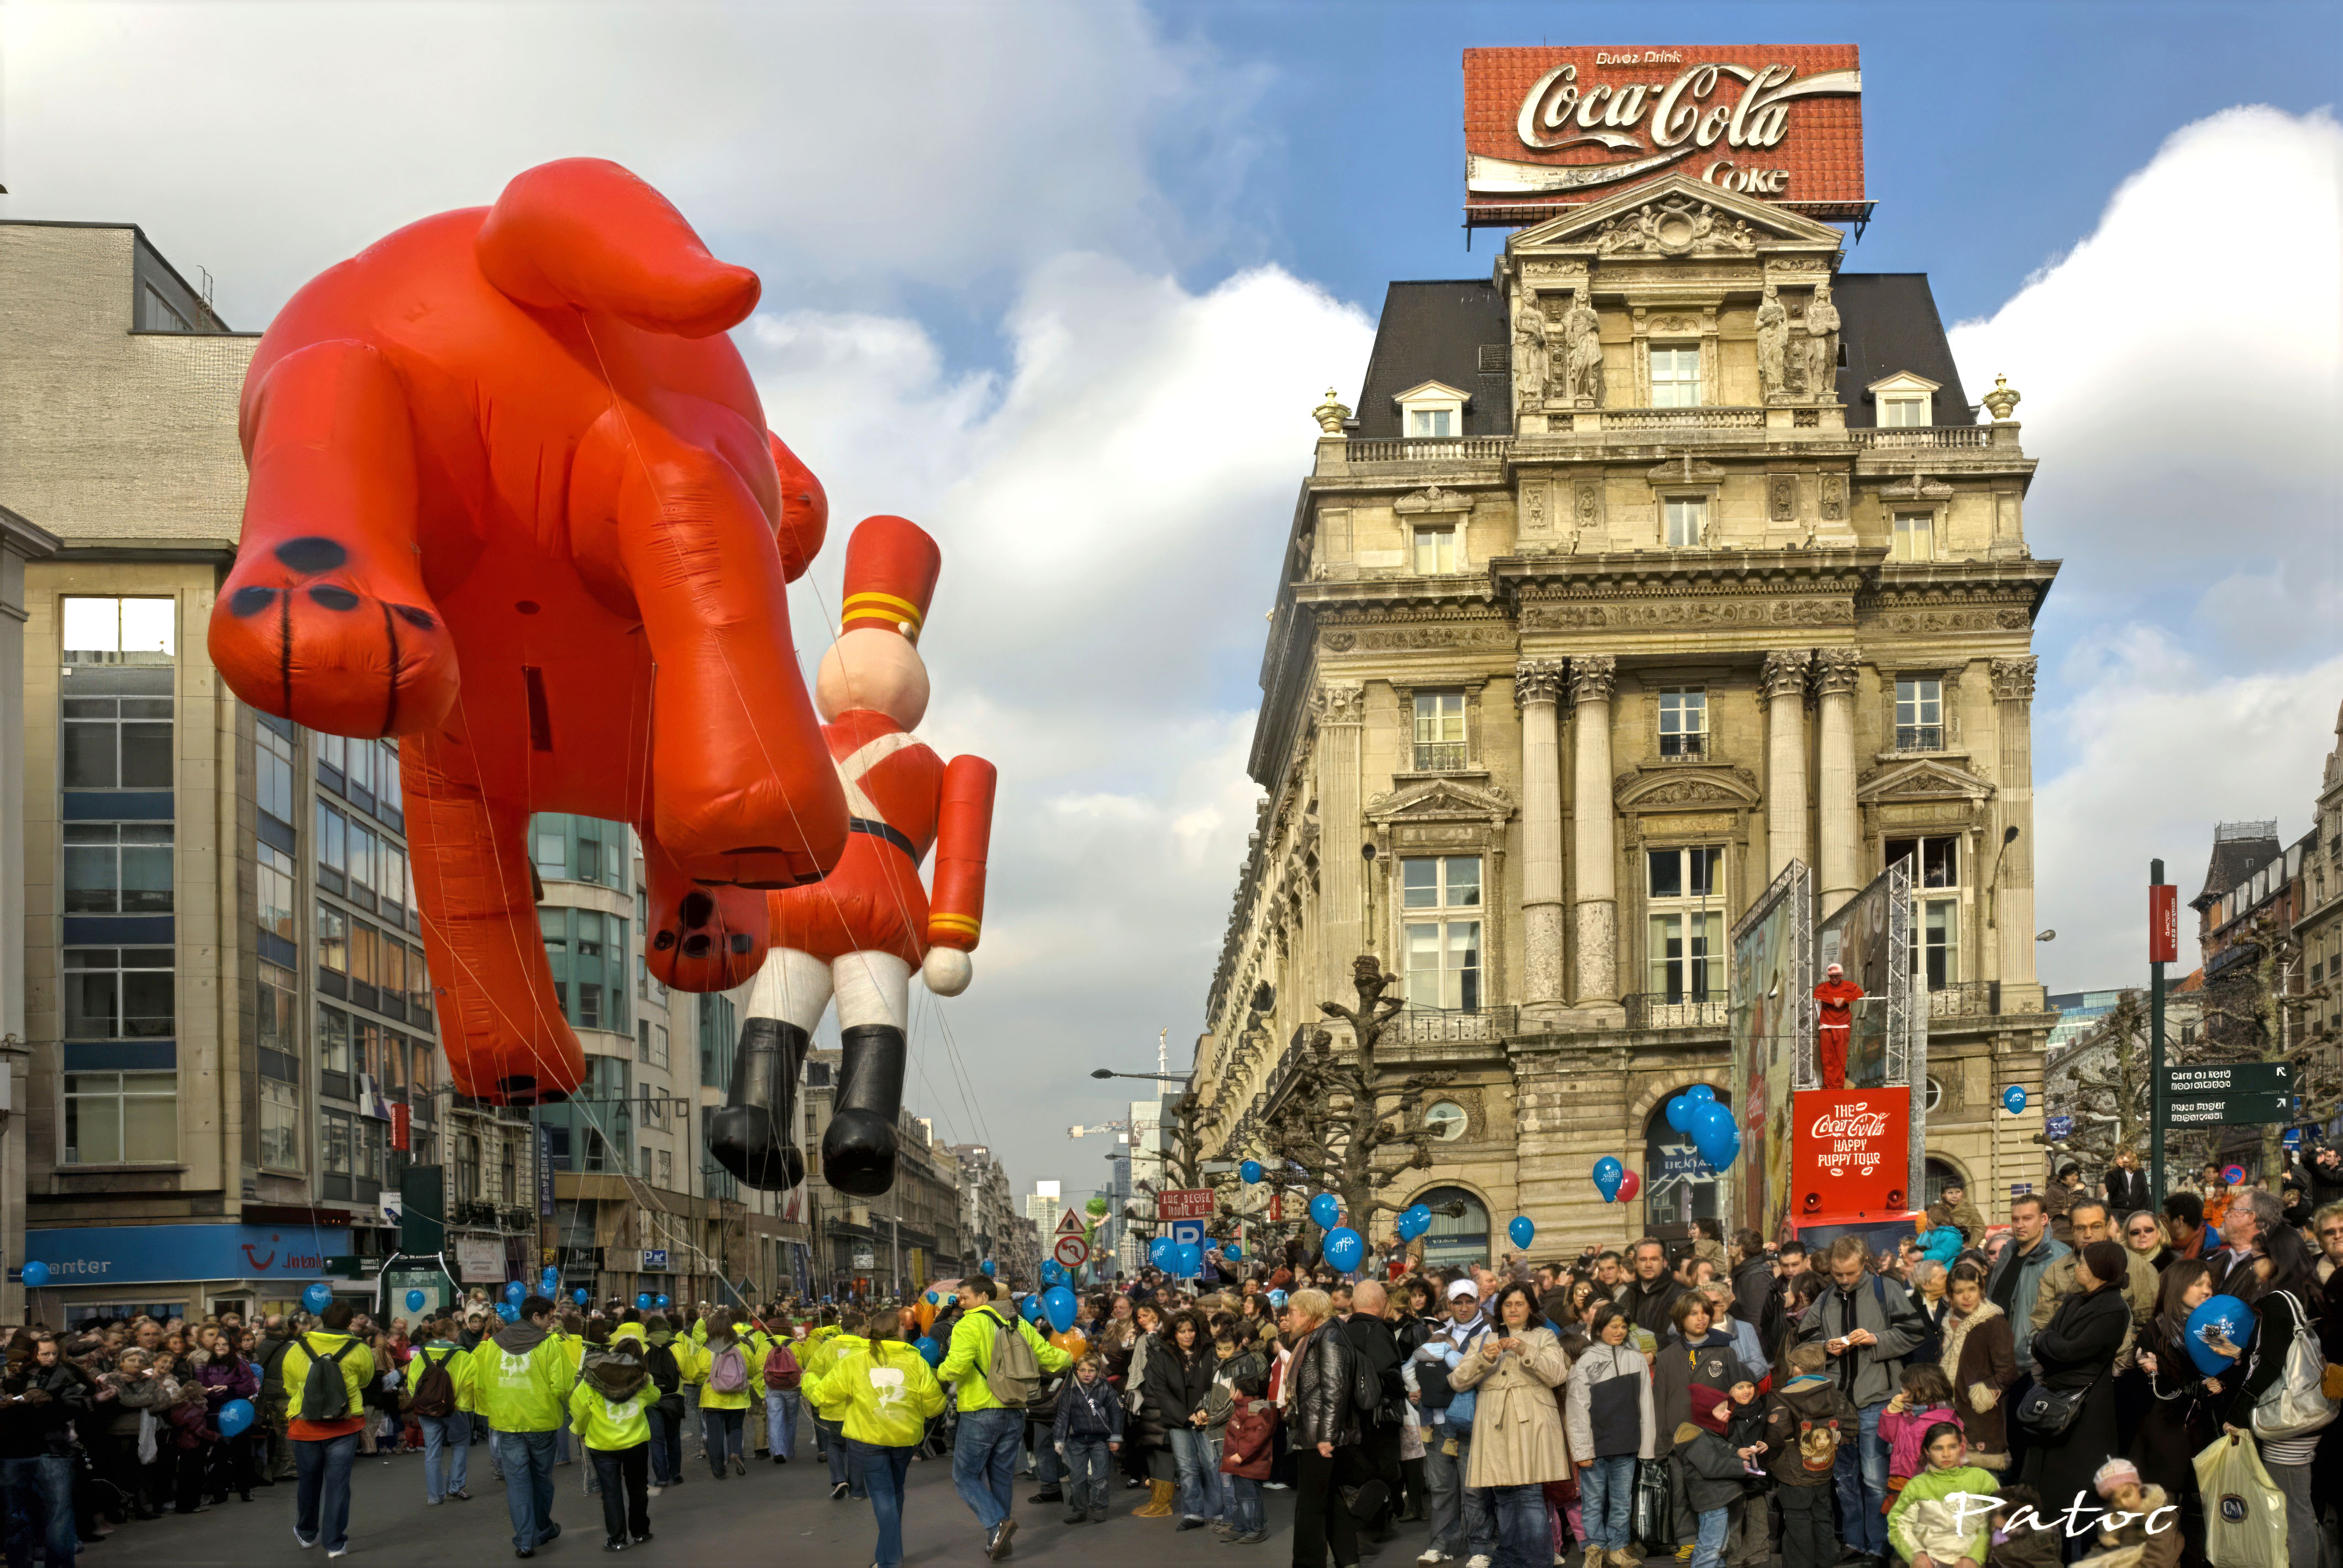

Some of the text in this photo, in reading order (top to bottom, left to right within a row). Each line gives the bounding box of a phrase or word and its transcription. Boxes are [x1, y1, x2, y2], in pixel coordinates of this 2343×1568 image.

[1517, 63, 1796, 149] Coca-Cola
[1834, 1105, 1855, 1118] THE
[1834, 1139, 1867, 1153] HAPPY
[1818, 1153, 1880, 1167] PUPPY TOUR
